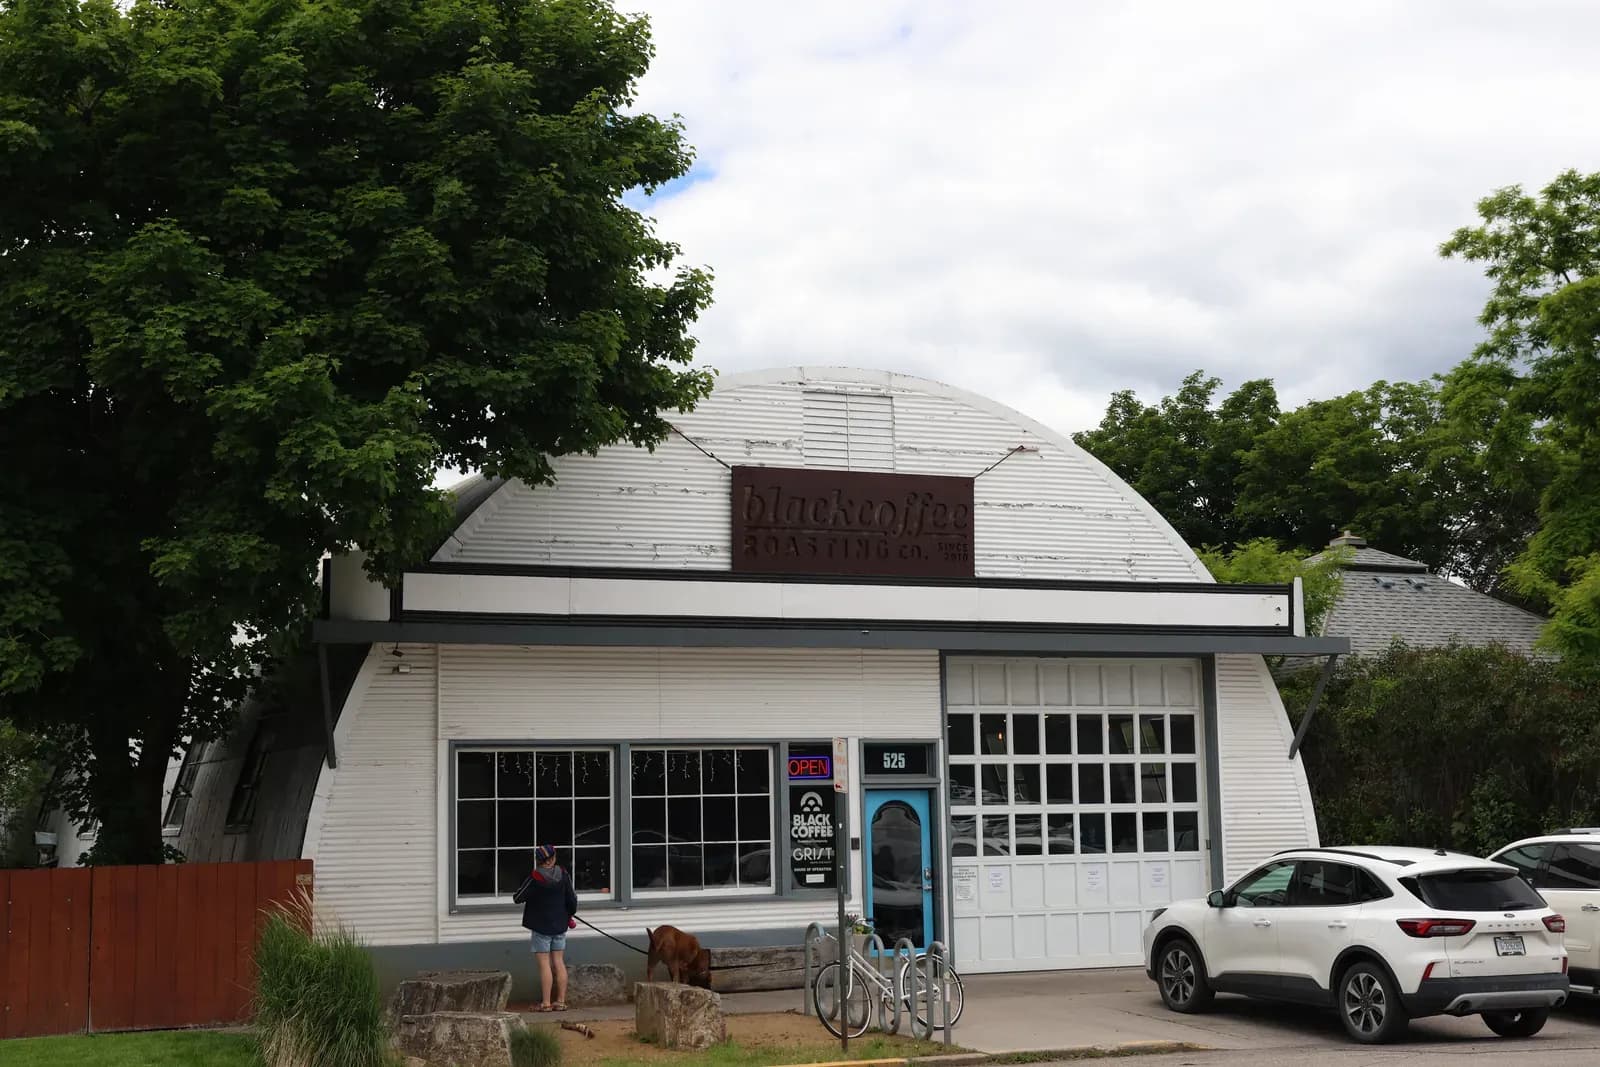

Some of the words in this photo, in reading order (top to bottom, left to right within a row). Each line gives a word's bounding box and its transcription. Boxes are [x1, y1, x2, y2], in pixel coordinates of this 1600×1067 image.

[743, 484, 969, 538] blackcoffee
[743, 535, 889, 560] ROASTING
[937, 542, 969, 552] SINCE
[787, 759, 828, 776] OPEN
[883, 752, 906, 769] 525
[792, 813, 831, 826] BLACK
[790, 825, 834, 838] COFFEE
[792, 847, 833, 861] GRIST
